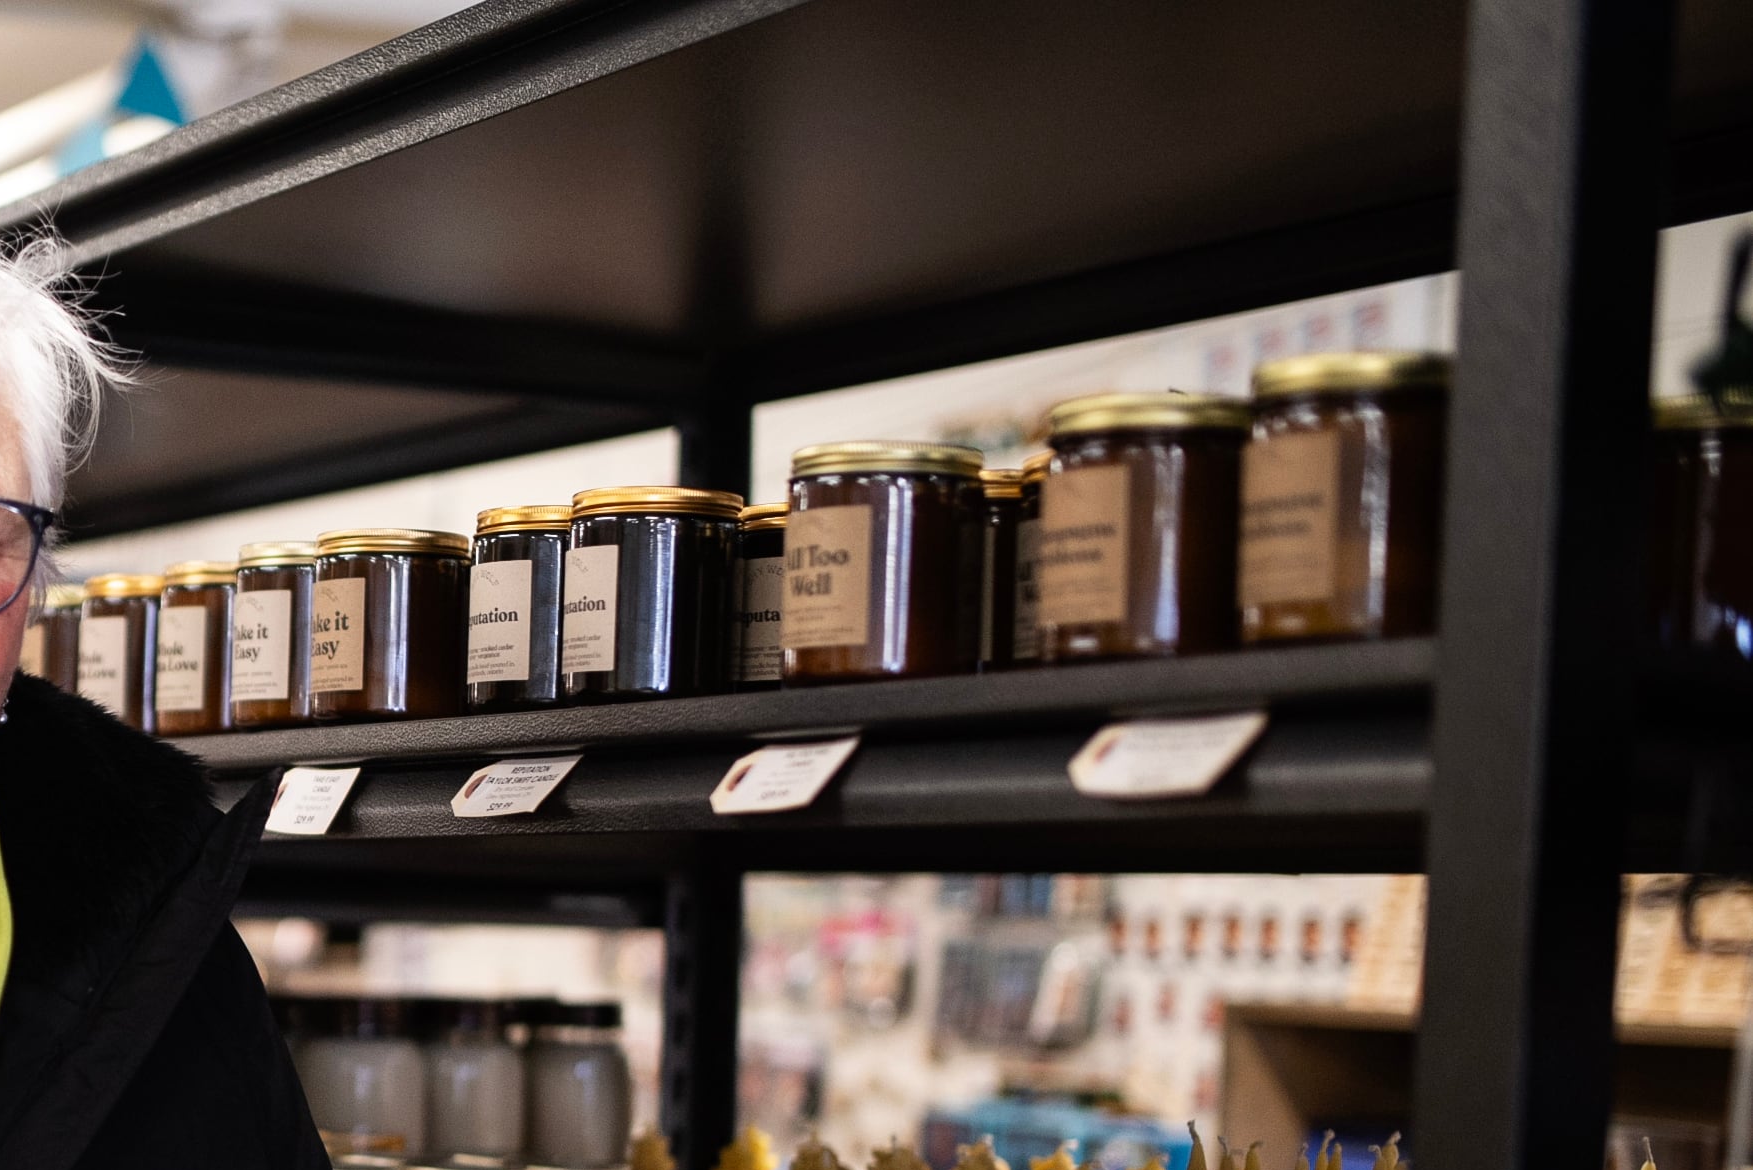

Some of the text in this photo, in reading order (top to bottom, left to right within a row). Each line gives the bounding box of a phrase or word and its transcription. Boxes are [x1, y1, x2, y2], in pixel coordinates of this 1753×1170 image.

[808, 544, 850, 568] Too
[790, 572, 832, 597] Well
[335, 611, 350, 631] it
[257, 623, 269, 639] it
[167, 660, 198, 672] Love
[511, 765, 552, 775] REPUTATION
[486, 773, 561, 785] TAYLOR SWIFT CANDLE
